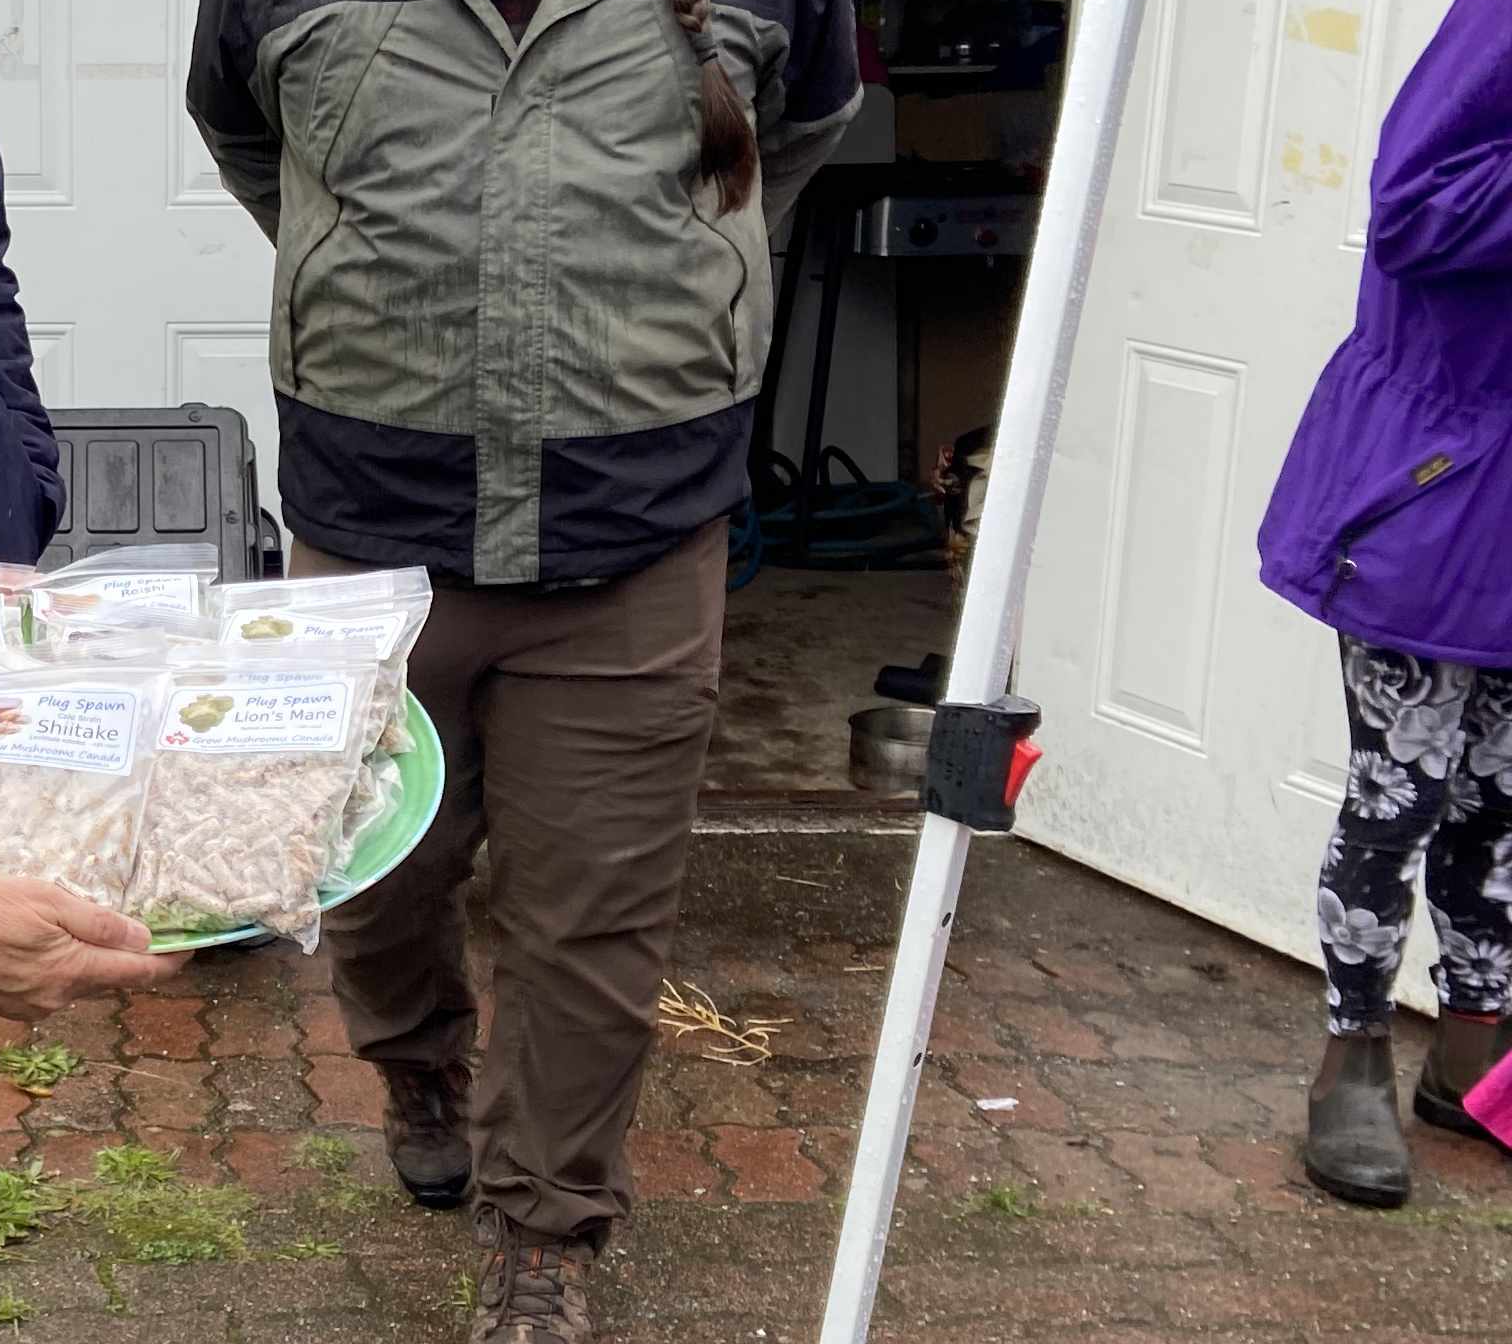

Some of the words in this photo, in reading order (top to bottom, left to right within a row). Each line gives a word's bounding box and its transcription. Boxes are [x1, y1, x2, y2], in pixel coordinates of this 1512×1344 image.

[104, 580, 131, 591] Plug
[304, 625, 333, 637] Plug
[341, 624, 385, 635] Spawn
[37, 696, 70, 710] Plug
[76, 699, 126, 713] Spawn
[246, 696, 277, 709] Plug
[282, 695, 332, 708] Spawn
[234, 710, 284, 723] Lion's
[290, 709, 337, 721] Mane
[36, 719, 119, 742] Shiitake
[192, 736, 222, 745] Grow
[225, 735, 287, 744] Mushrooms
[291, 734, 334, 743] Canada
[11, 744, 75, 759] Mushrooms
[79, 751, 121, 763] Canada
